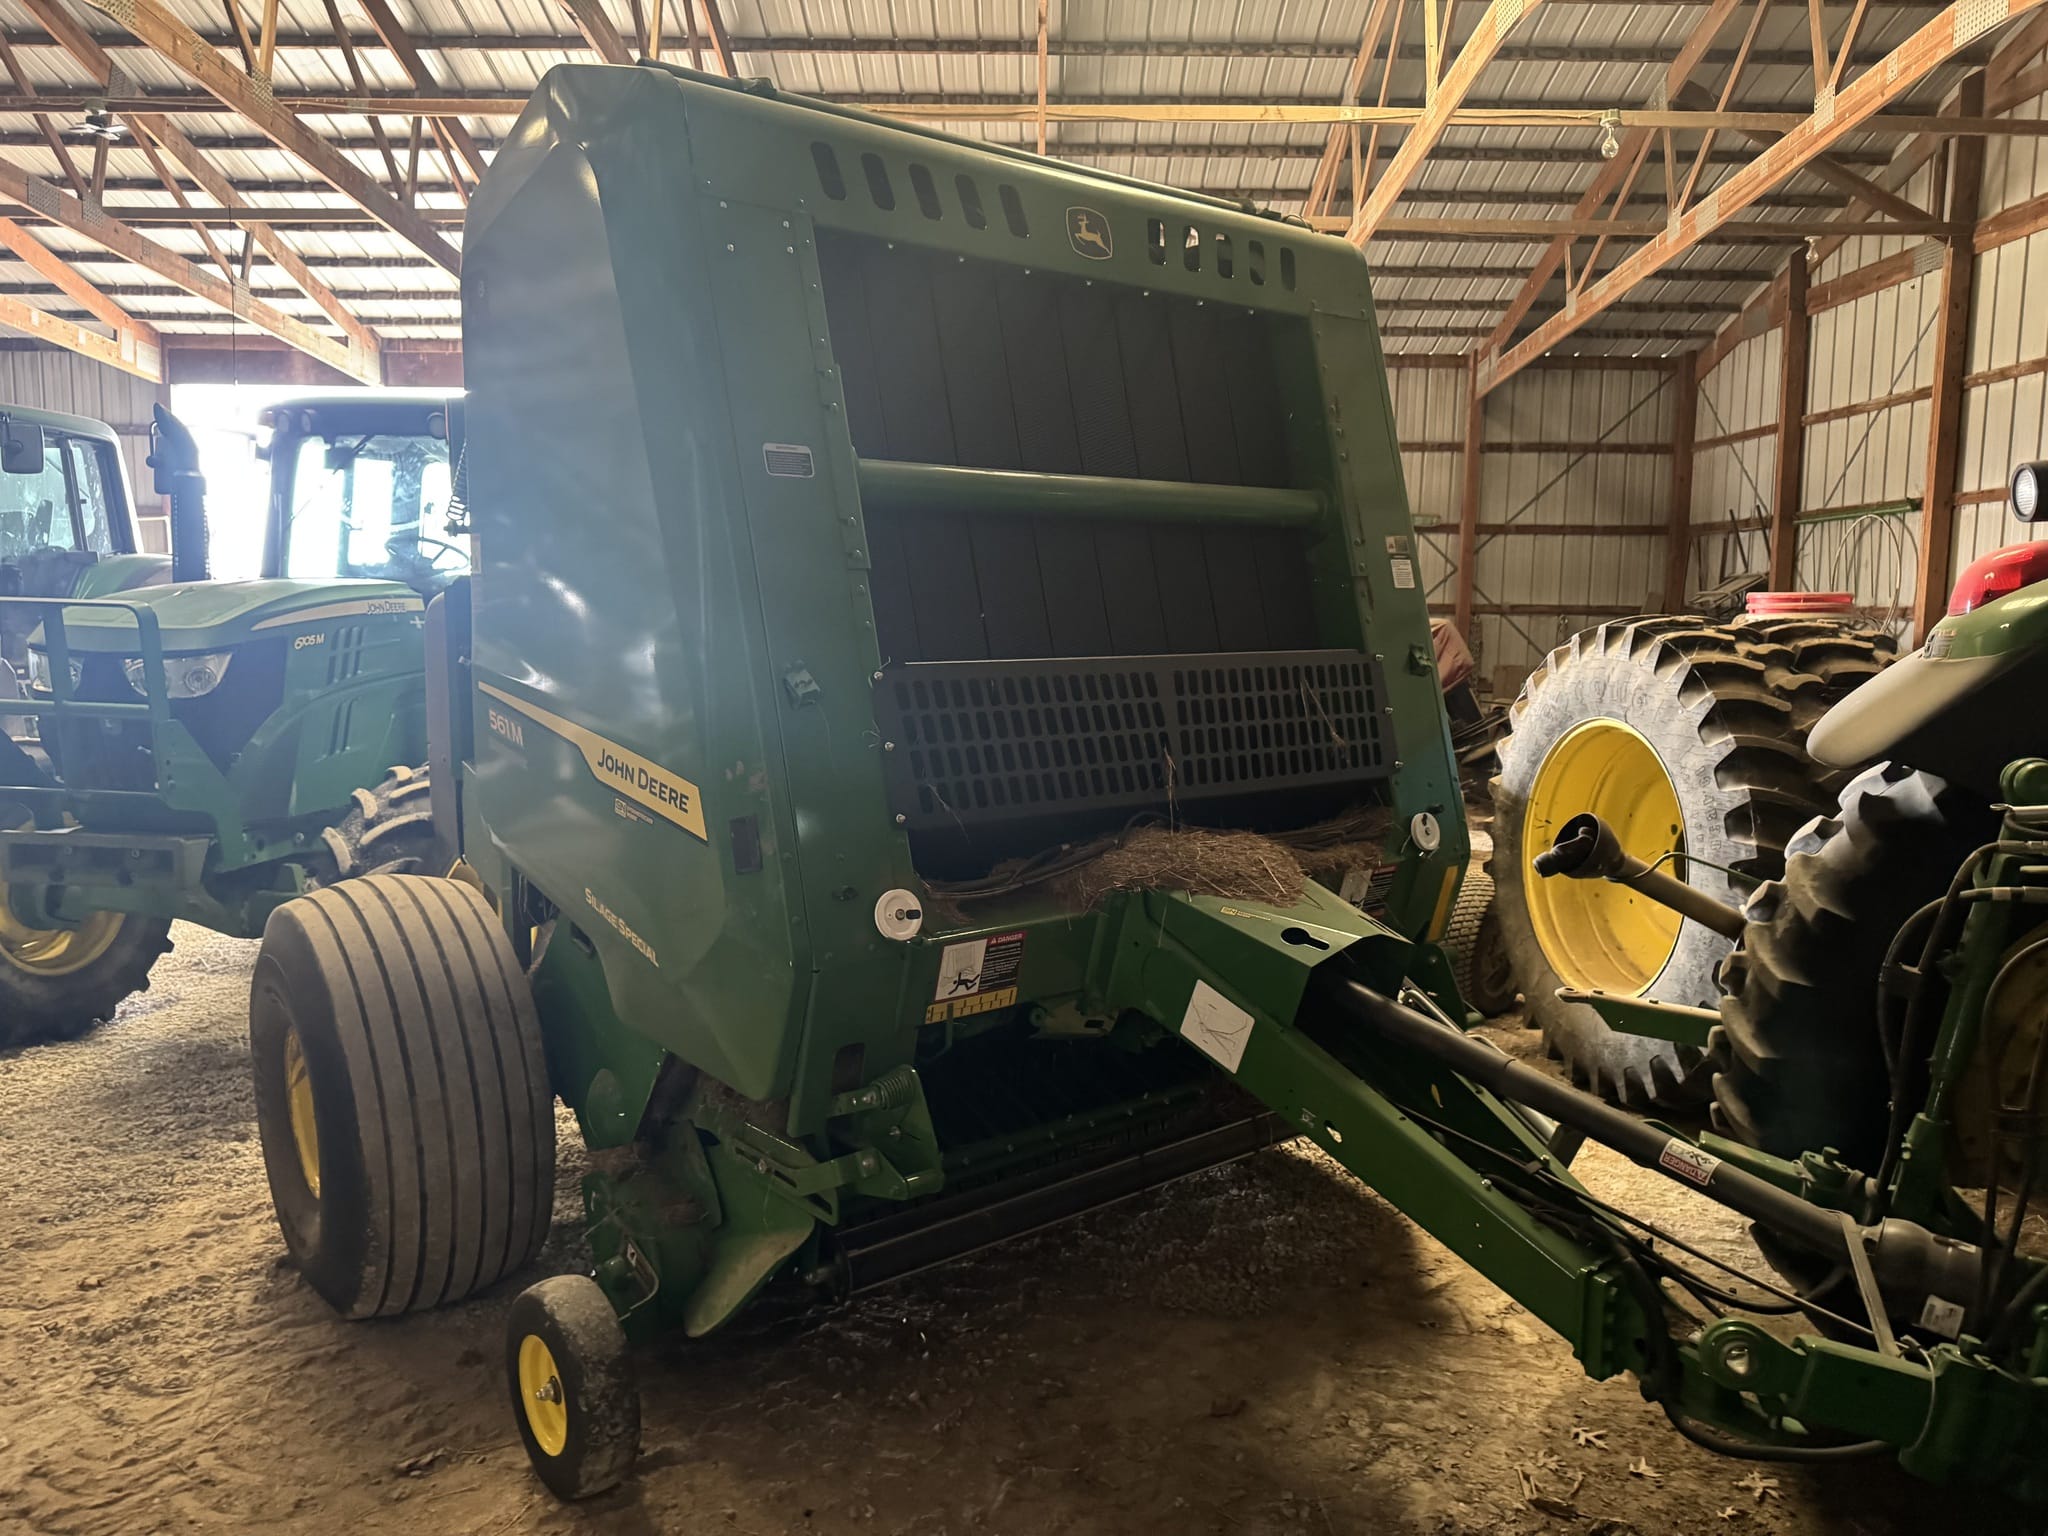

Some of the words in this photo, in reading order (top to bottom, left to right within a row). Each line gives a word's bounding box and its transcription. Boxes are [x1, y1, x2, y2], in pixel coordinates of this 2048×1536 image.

[367, 601, 385, 615] JOHN
[385, 600, 406, 613] DEERE
[488, 708, 524, 747] 561M
[597, 748, 635, 785] JOHN
[637, 767, 690, 814] DEERE
[585, 887, 619, 929] SILAGE
[618, 917, 660, 968] SPECIAL
[1663, 1153, 1700, 1178] DANGER
